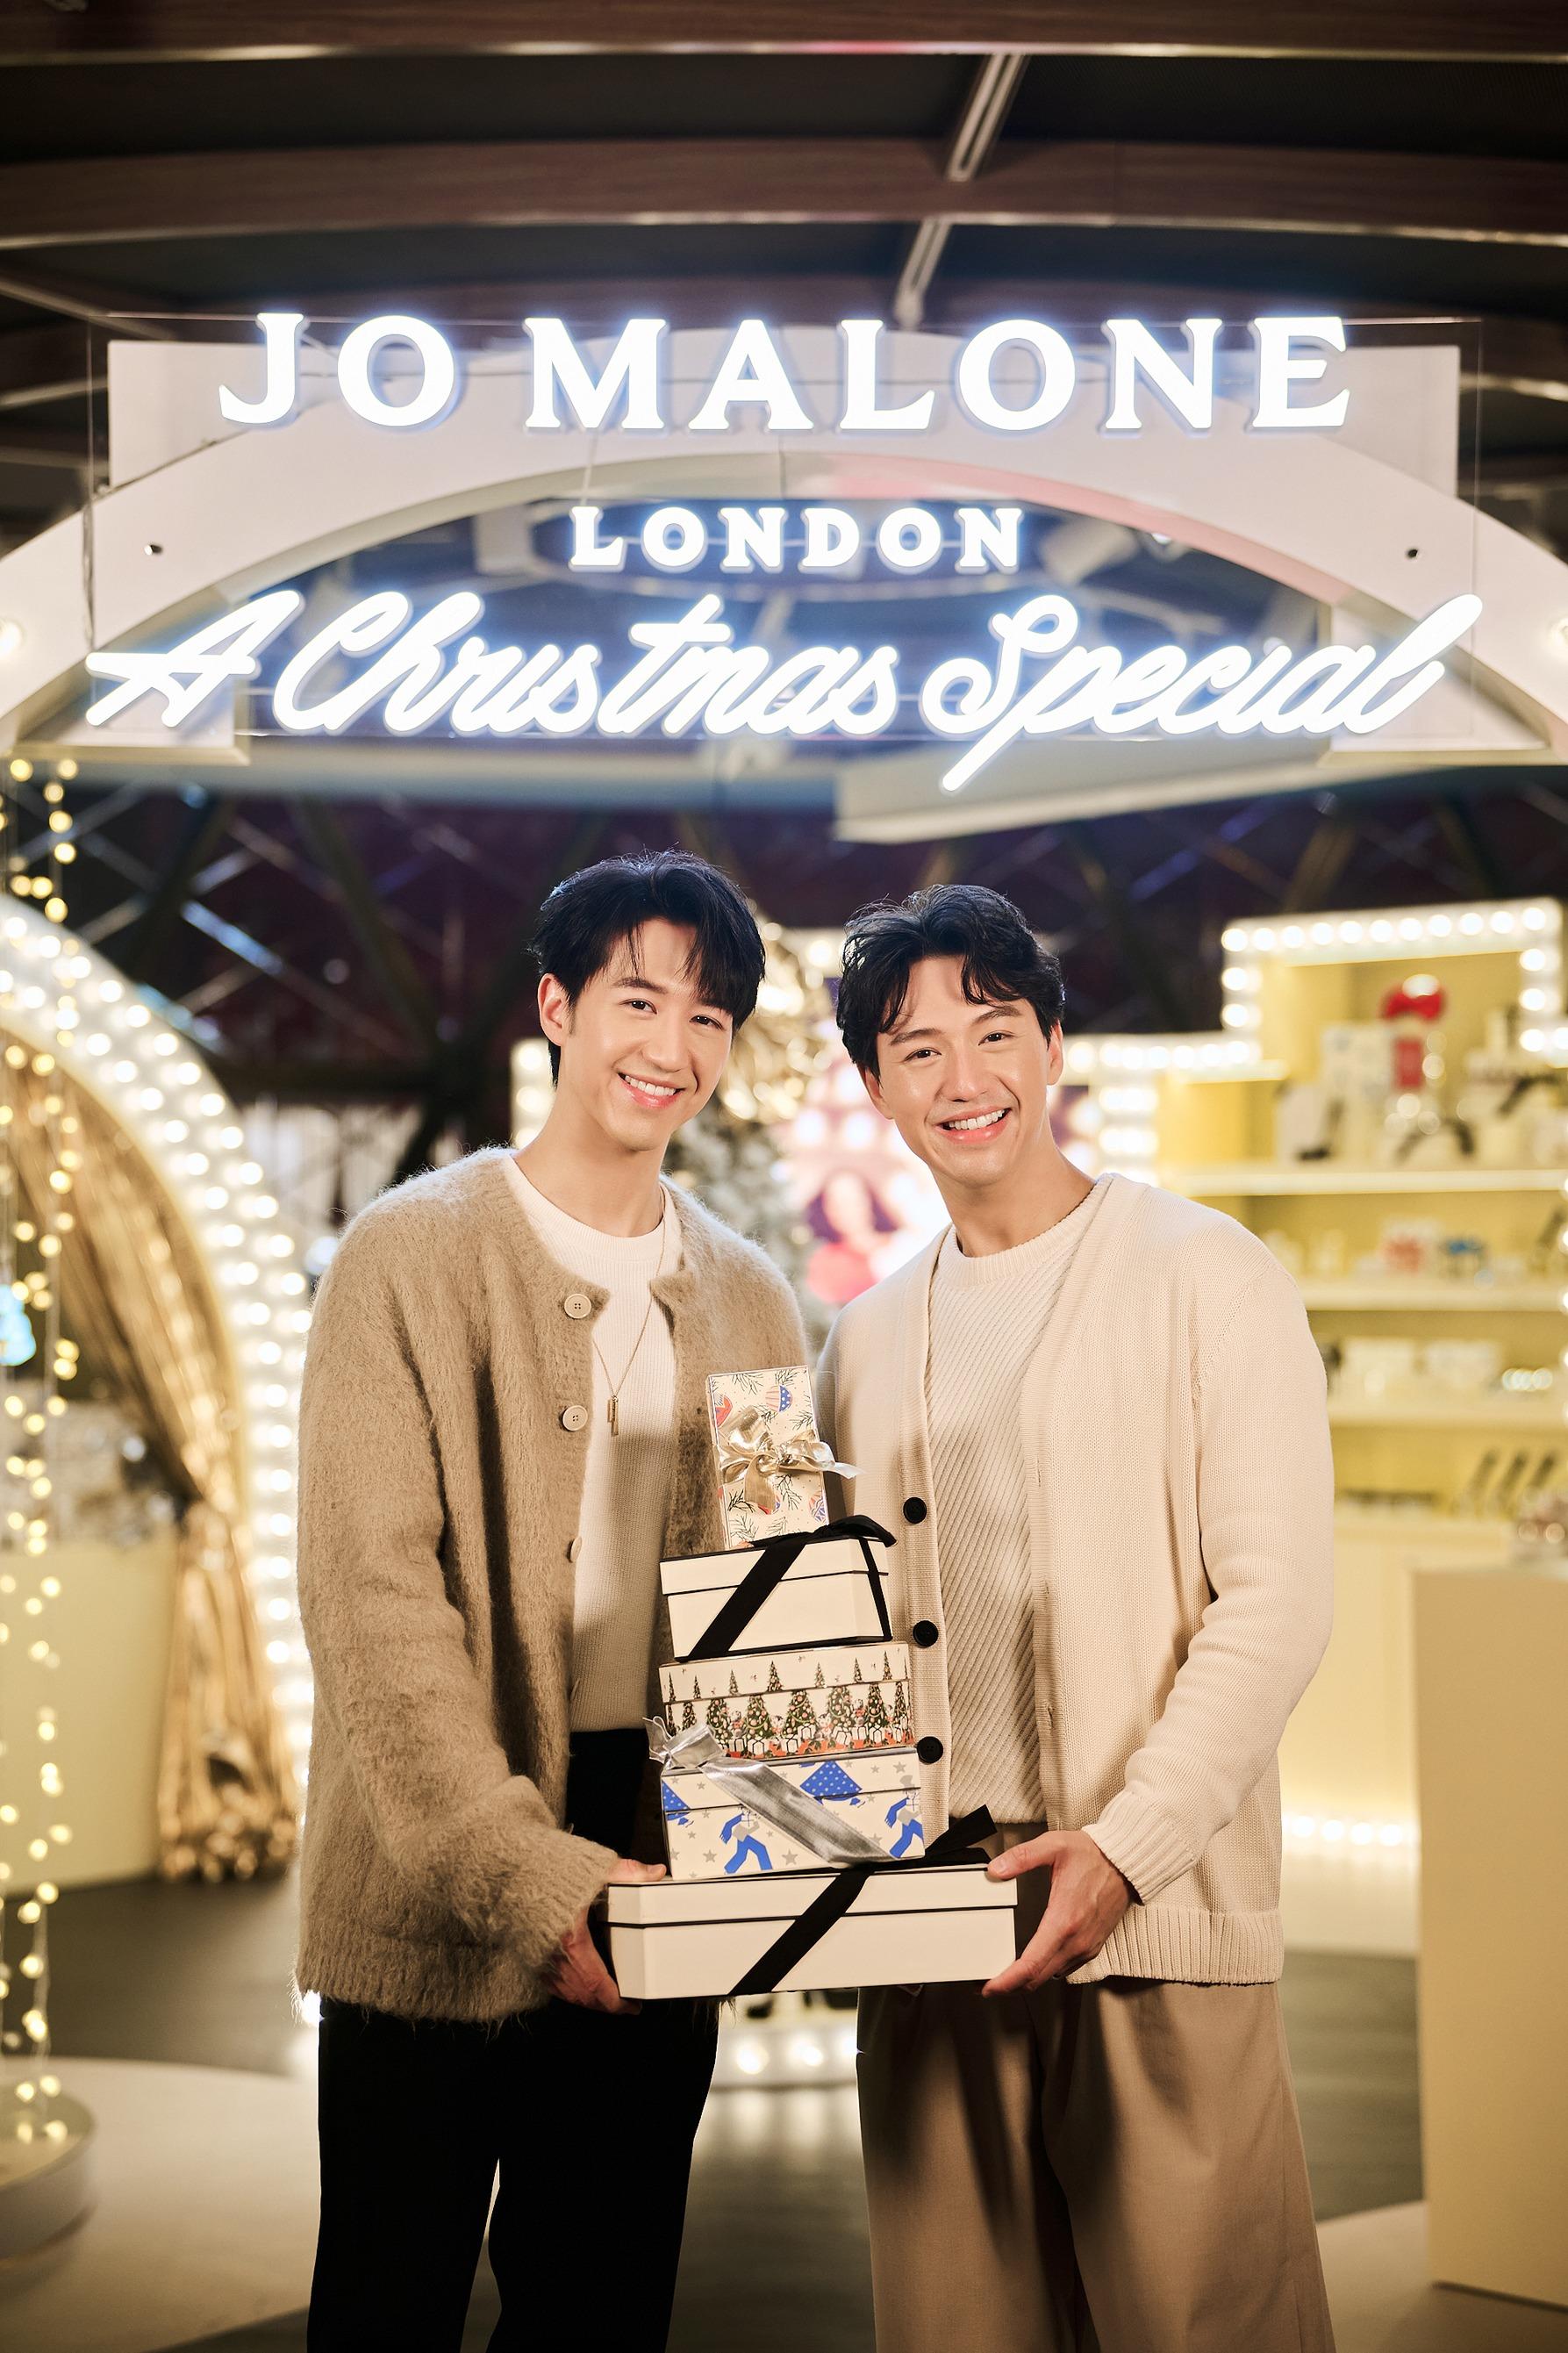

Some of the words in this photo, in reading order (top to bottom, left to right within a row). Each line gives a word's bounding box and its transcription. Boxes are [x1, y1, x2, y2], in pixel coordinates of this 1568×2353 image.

[219, 312, 457, 427] JO
[523, 315, 1352, 432] MALONE
[569, 506, 1024, 573] LONDON
[85, 589, 304, 728] A
[273, 591, 899, 737] Christmas
[920, 593, 1483, 793] Special
